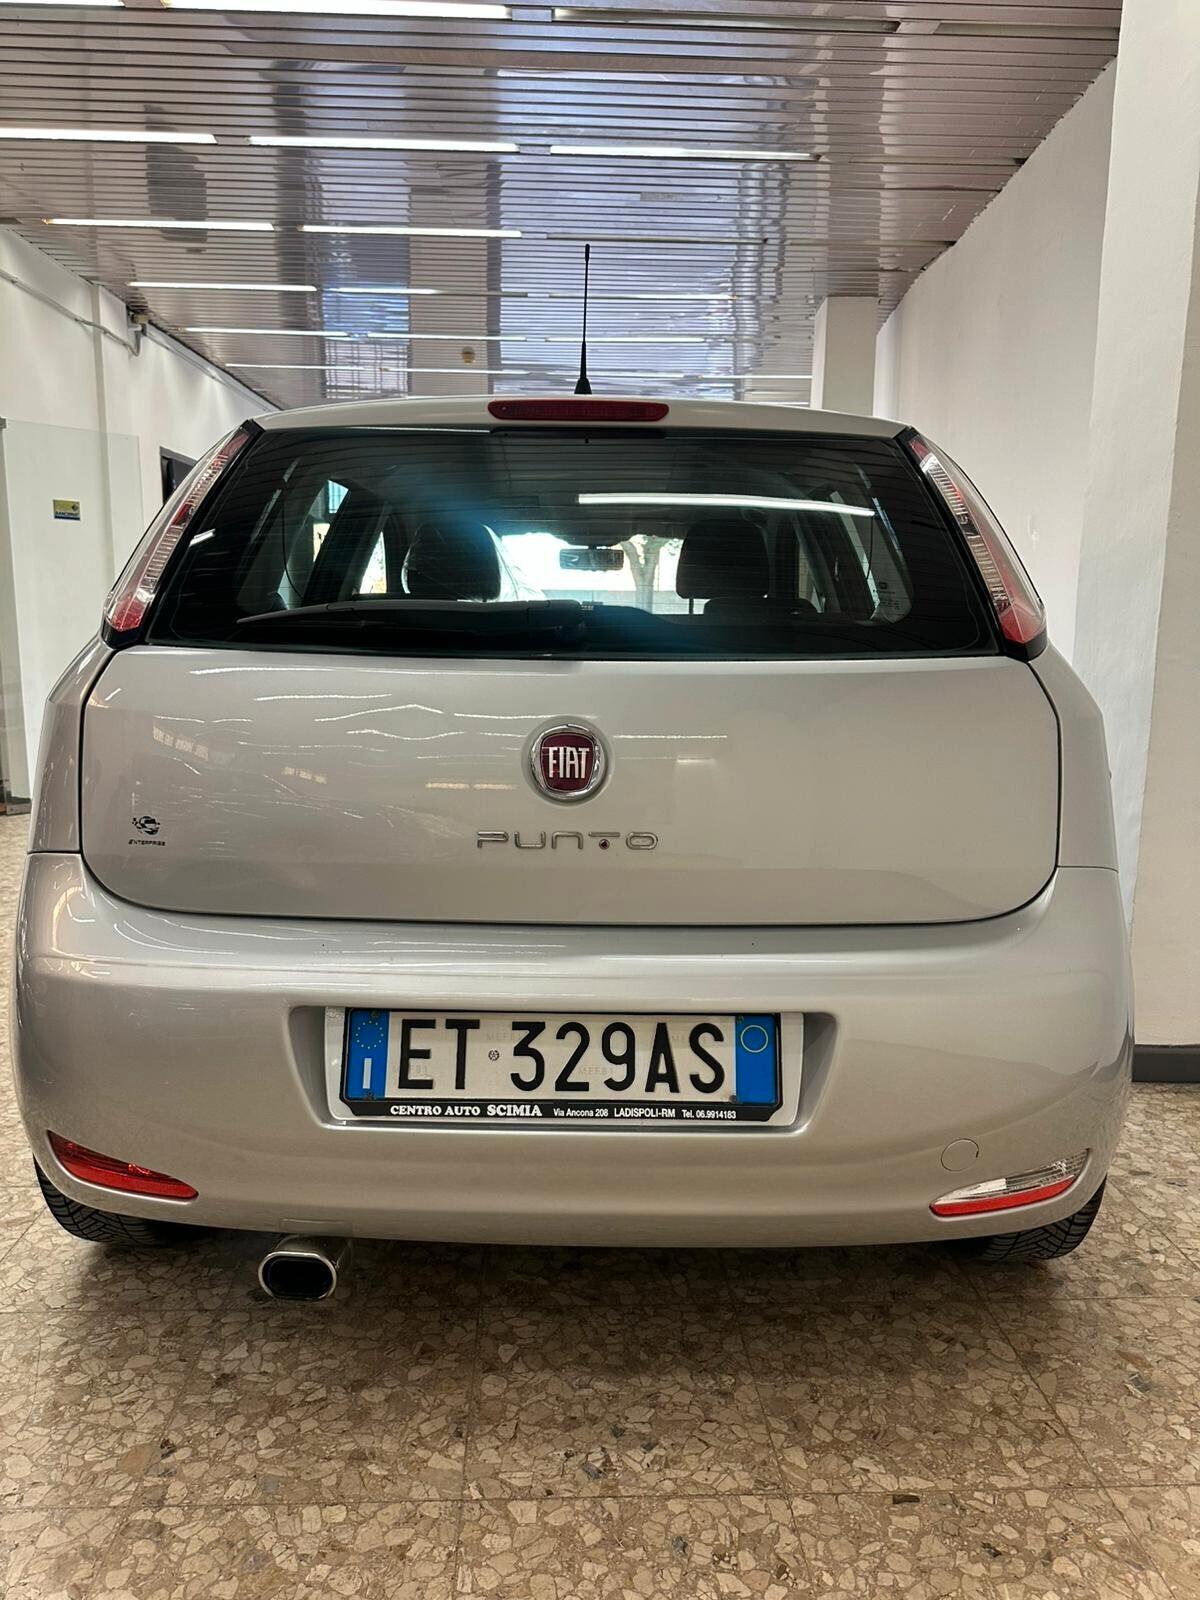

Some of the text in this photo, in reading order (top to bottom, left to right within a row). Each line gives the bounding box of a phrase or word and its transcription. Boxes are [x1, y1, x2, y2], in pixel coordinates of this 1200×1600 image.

[548, 746, 590, 779] FIAT
[476, 831, 659, 850] PUNTO
[398, 1018, 726, 1094] ET 329AS
[389, 1105, 442, 1116] CENTRO
[444, 1105, 481, 1116] AUTO
[486, 1104, 543, 1117] SCIMIA
[553, 1108, 565, 1117] Via
[566, 1108, 594, 1117] Ancona
[613, 1107, 676, 1118] LADISPOLI-RM
[681, 1109, 695, 1118] Tel.
